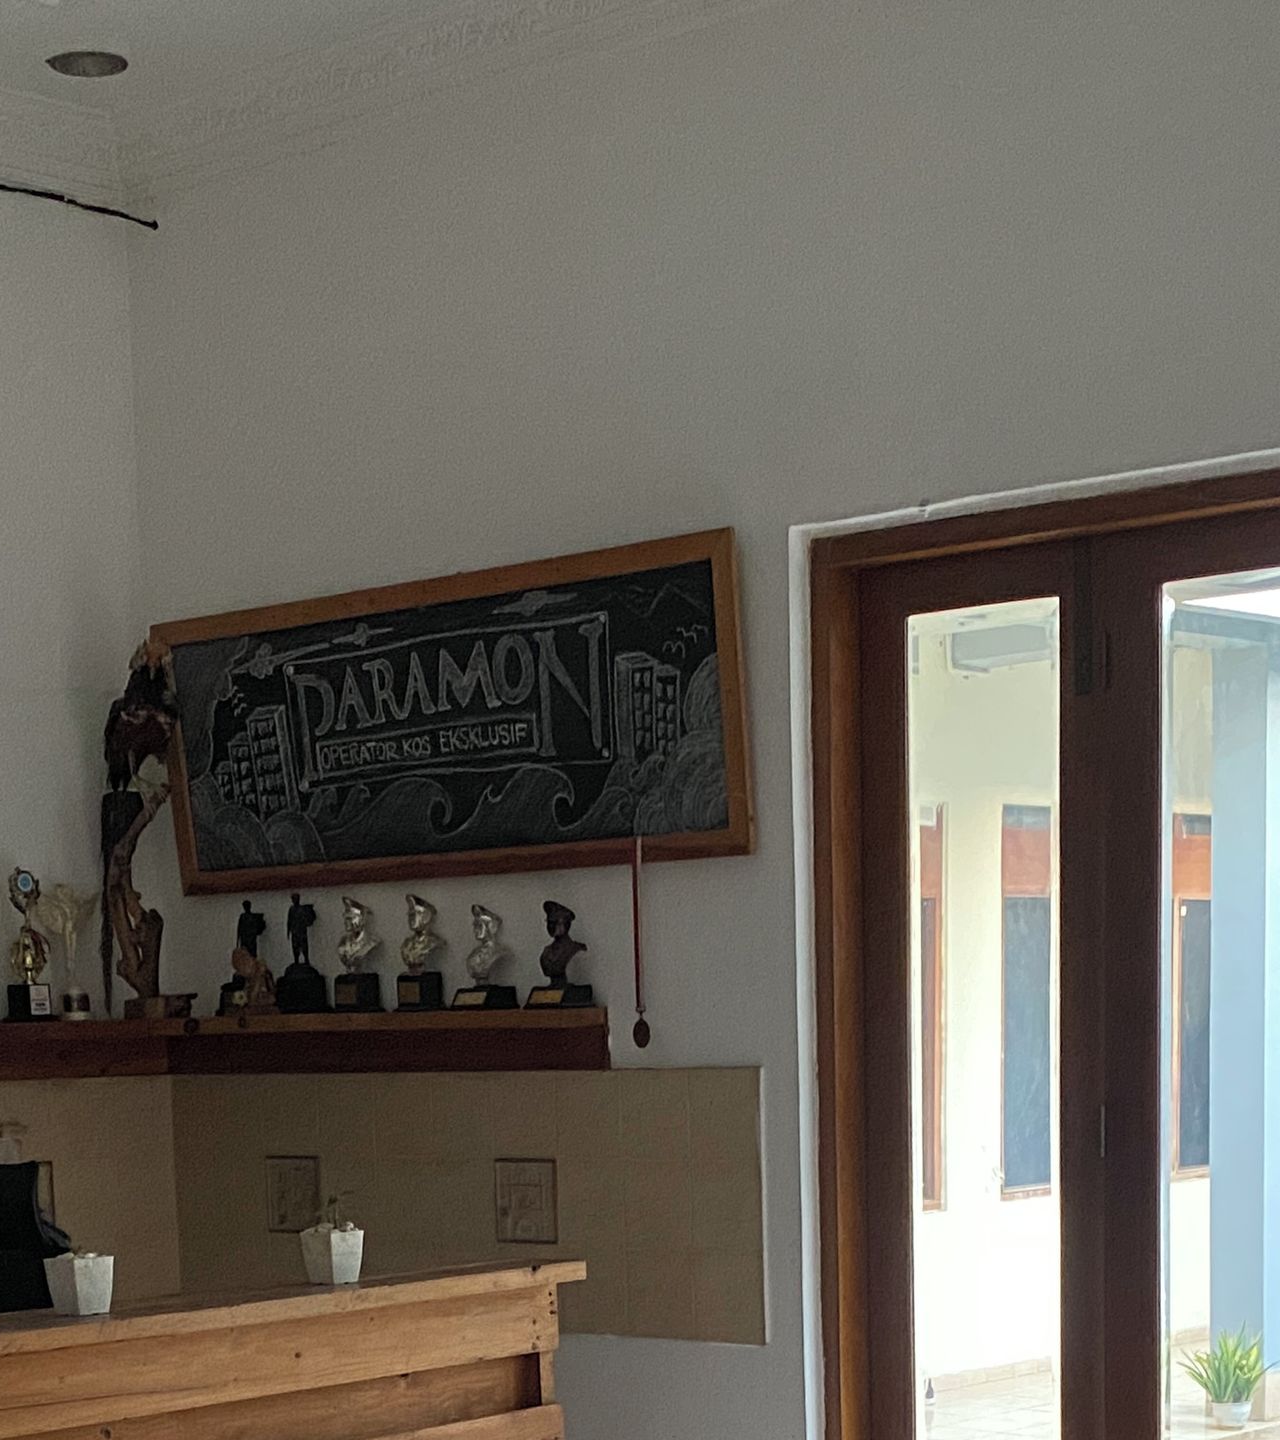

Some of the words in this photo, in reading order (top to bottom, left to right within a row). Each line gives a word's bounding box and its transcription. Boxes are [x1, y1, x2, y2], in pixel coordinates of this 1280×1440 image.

[290, 622, 604, 780] PARAMON
[320, 739, 398, 769] OPERATOR
[403, 734, 432, 757] KOS
[439, 723, 528, 754] EKSKLUSIF
